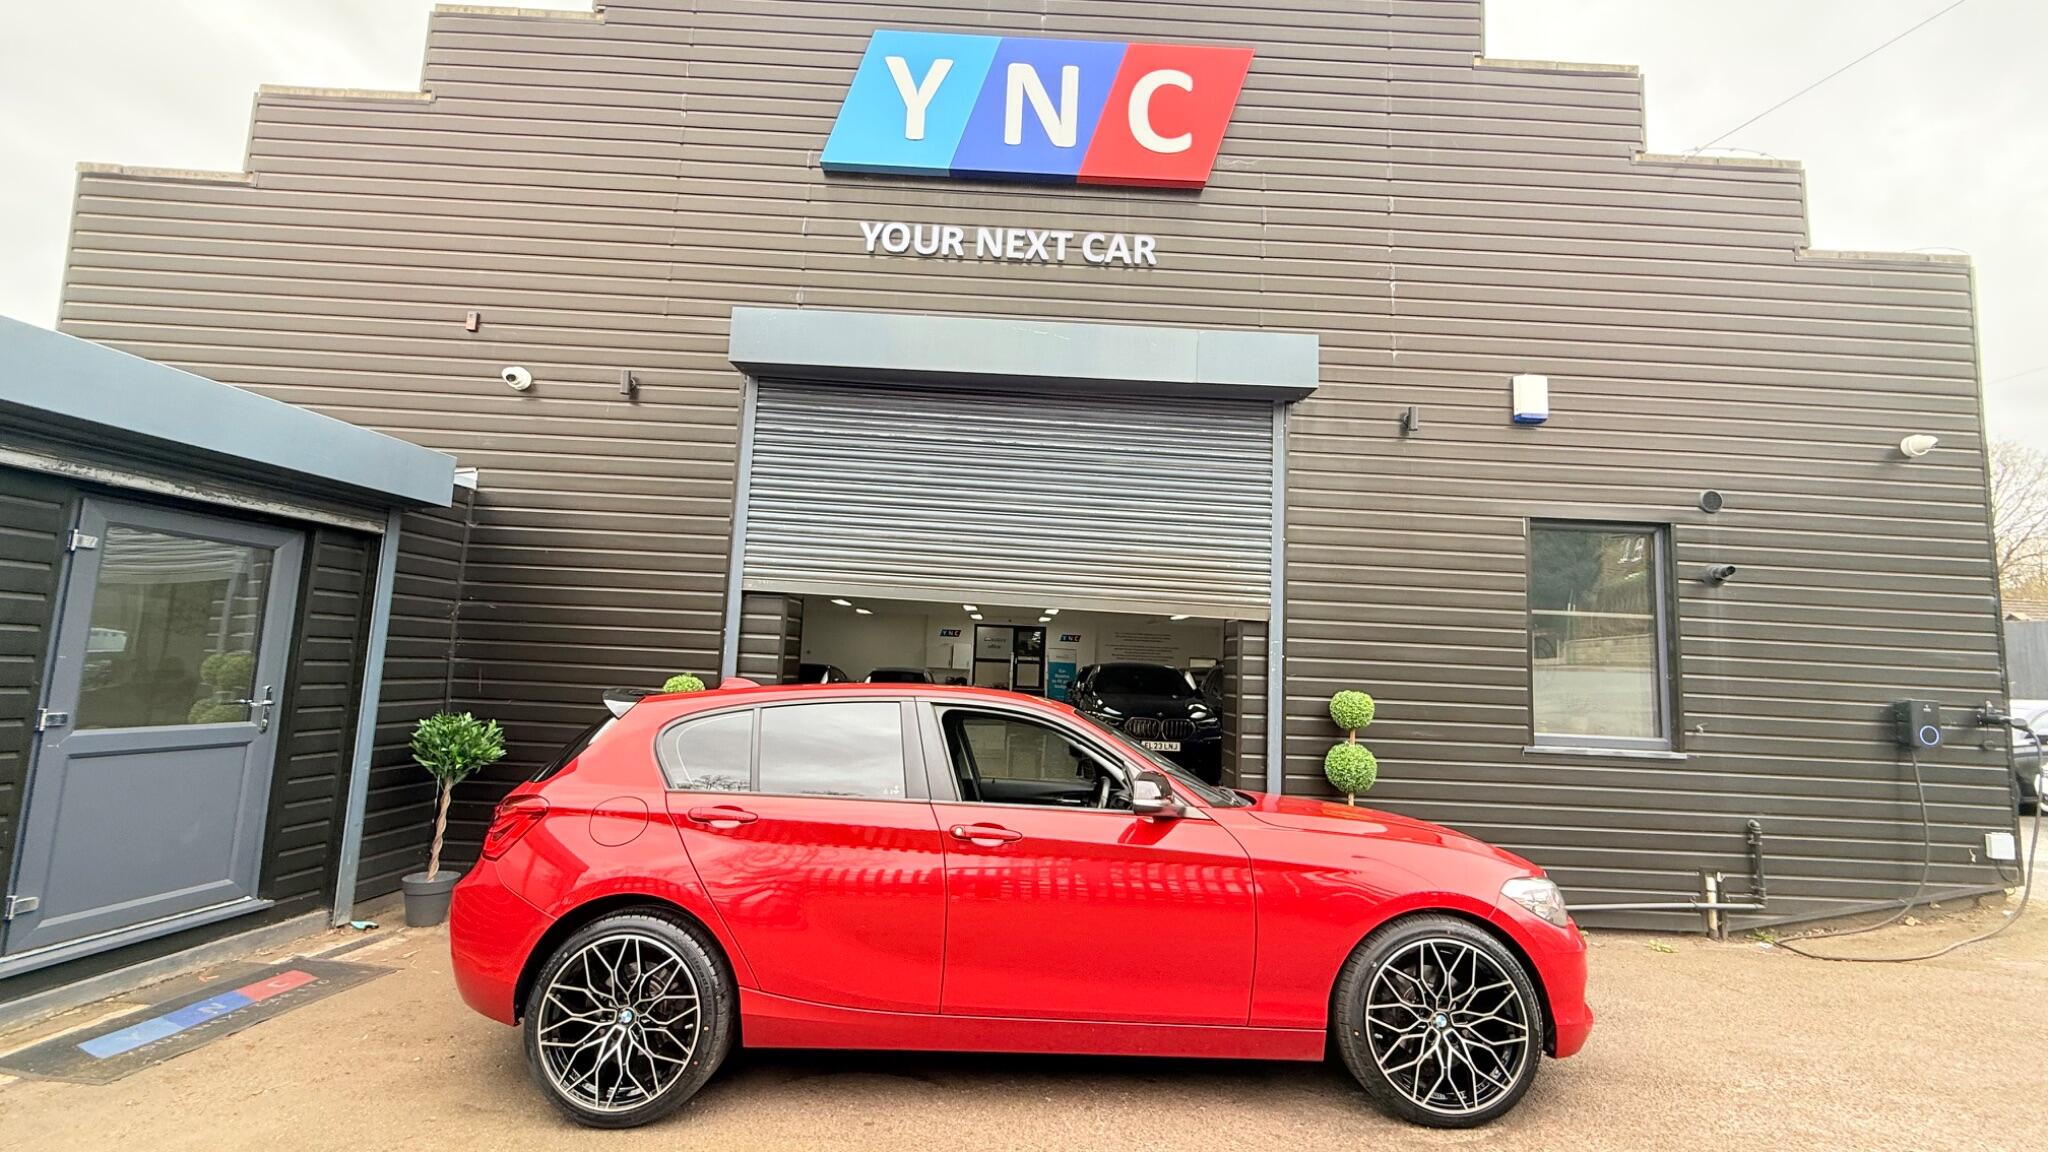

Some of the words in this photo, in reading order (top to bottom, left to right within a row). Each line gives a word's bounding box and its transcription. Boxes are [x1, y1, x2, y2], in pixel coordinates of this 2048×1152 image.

[885, 56, 1194, 153] YNC
[860, 222, 964, 257] YOUR
[976, 228, 1075, 261] NEXT
[1082, 232, 1159, 266] CAR
